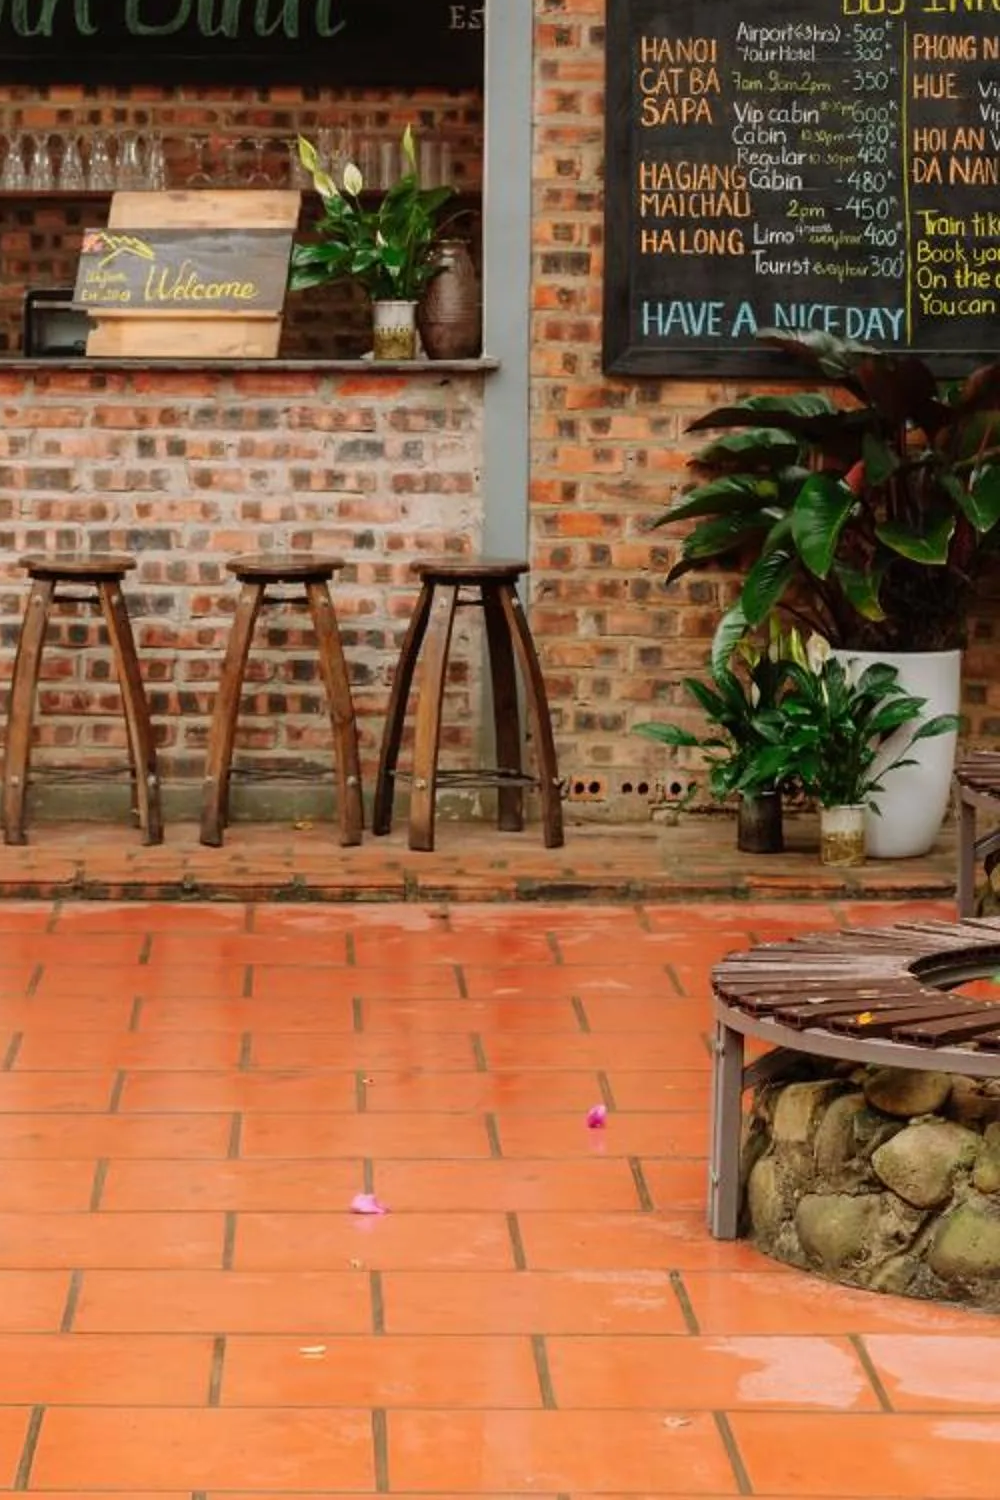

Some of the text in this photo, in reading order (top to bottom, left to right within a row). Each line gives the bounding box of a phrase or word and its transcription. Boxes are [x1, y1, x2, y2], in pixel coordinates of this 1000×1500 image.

[641, 36, 717, 63] HANOI
[913, 33, 976, 61] PHONG
[640, 67, 721, 95] CAT BA
[913, 72, 1000, 101] HUE Vi
[641, 97, 713, 127] SAPA
[733, 101, 763, 129] Vip
[768, 101, 819, 124] cabin
[732, 123, 787, 145] Cabin
[913, 127, 947, 152] HOI
[952, 127, 985, 151] AN
[737, 145, 807, 172] Regular
[750, 167, 803, 190] Cabin
[786, 200, 825, 220] 2pm
[915, 209, 1000, 236] Train tik
[640, 229, 745, 255] HALONG
[753, 223, 795, 245] Limo
[751, 250, 810, 275] Tourist
[917, 240, 1000, 267] Book yo
[144, 259, 258, 300] Welcome
[917, 266, 947, 289] On
[955, 262, 991, 289] the
[643, 301, 724, 337] HAVE
[732, 301, 757, 338] A
[845, 307, 905, 341] DAY
